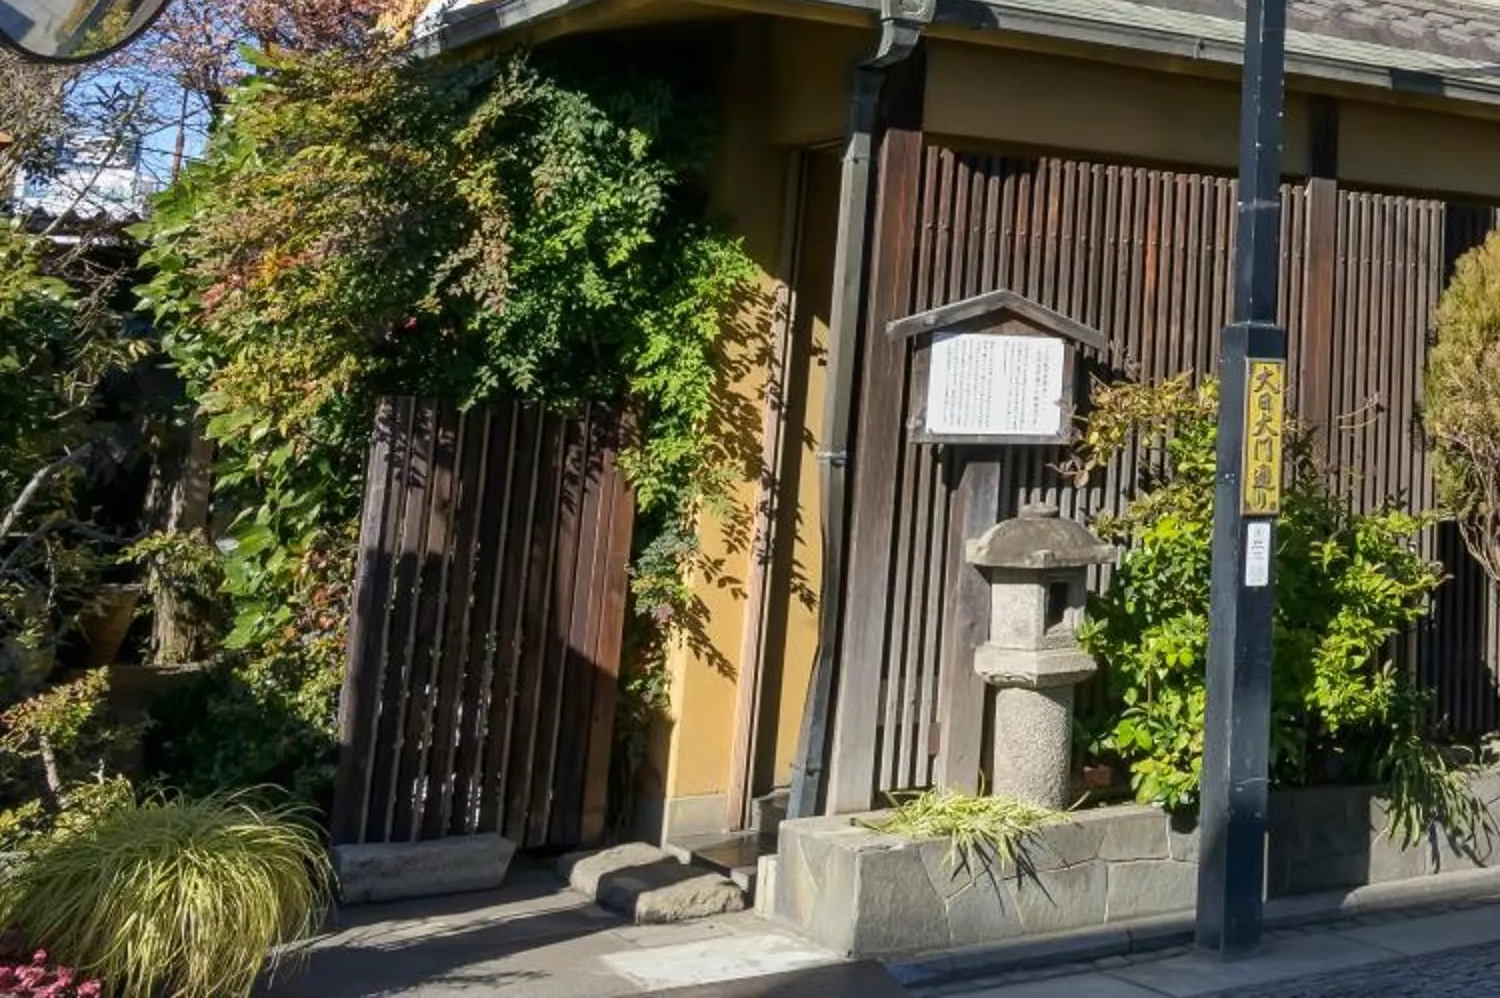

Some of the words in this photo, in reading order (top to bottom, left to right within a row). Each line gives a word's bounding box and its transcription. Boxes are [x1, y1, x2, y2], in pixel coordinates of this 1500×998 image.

[1252, 366, 1280, 510] 大日大門通り
